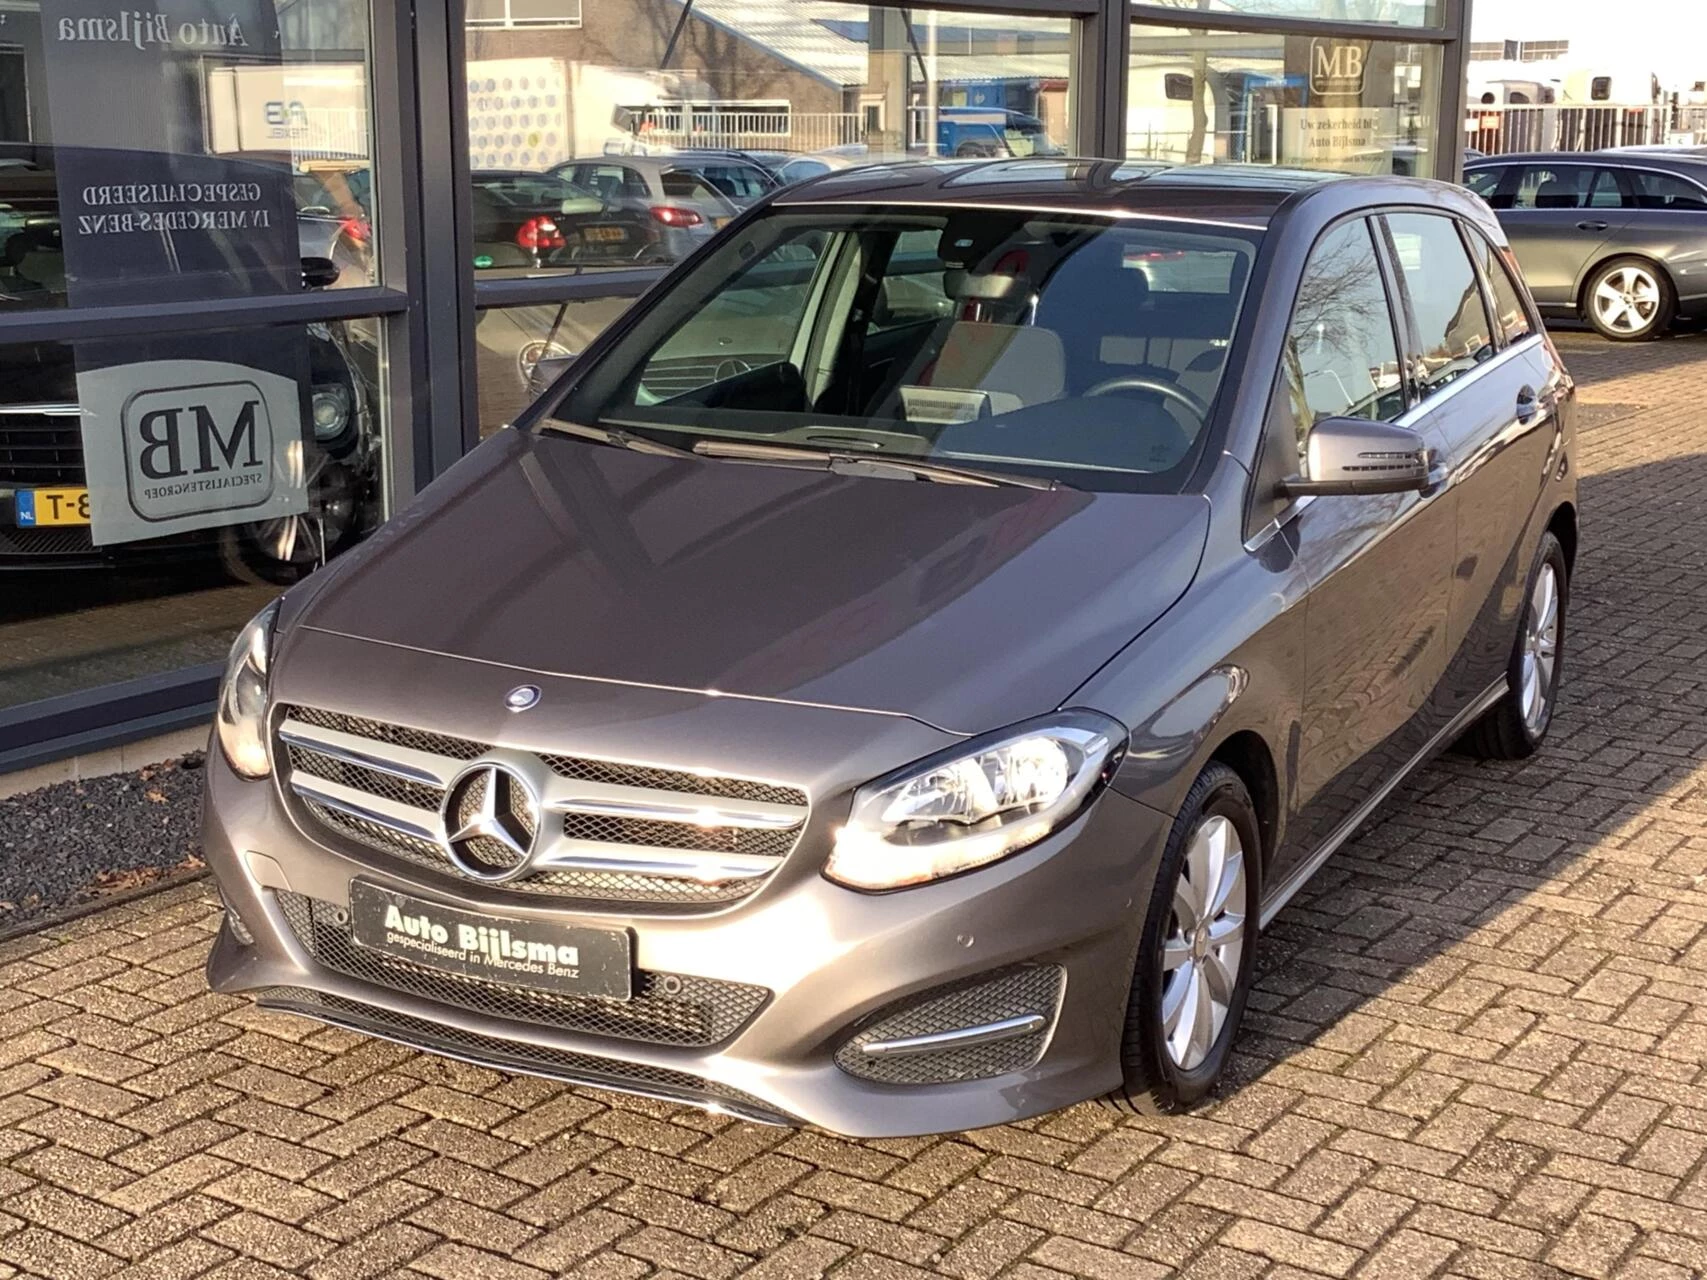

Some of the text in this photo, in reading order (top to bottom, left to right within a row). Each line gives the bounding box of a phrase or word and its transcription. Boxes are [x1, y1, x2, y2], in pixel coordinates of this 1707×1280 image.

[1315, 46, 1362, 78] MB
[1317, 117, 1361, 131] zekerheid
[1309, 136, 1366, 151] Auto Bijlsma
[20, 511, 34, 520] NL
[384, 904, 580, 966] Auto Bijlsma
[386, 930, 581, 979] gespecialiseerd in Mercedes Benz
